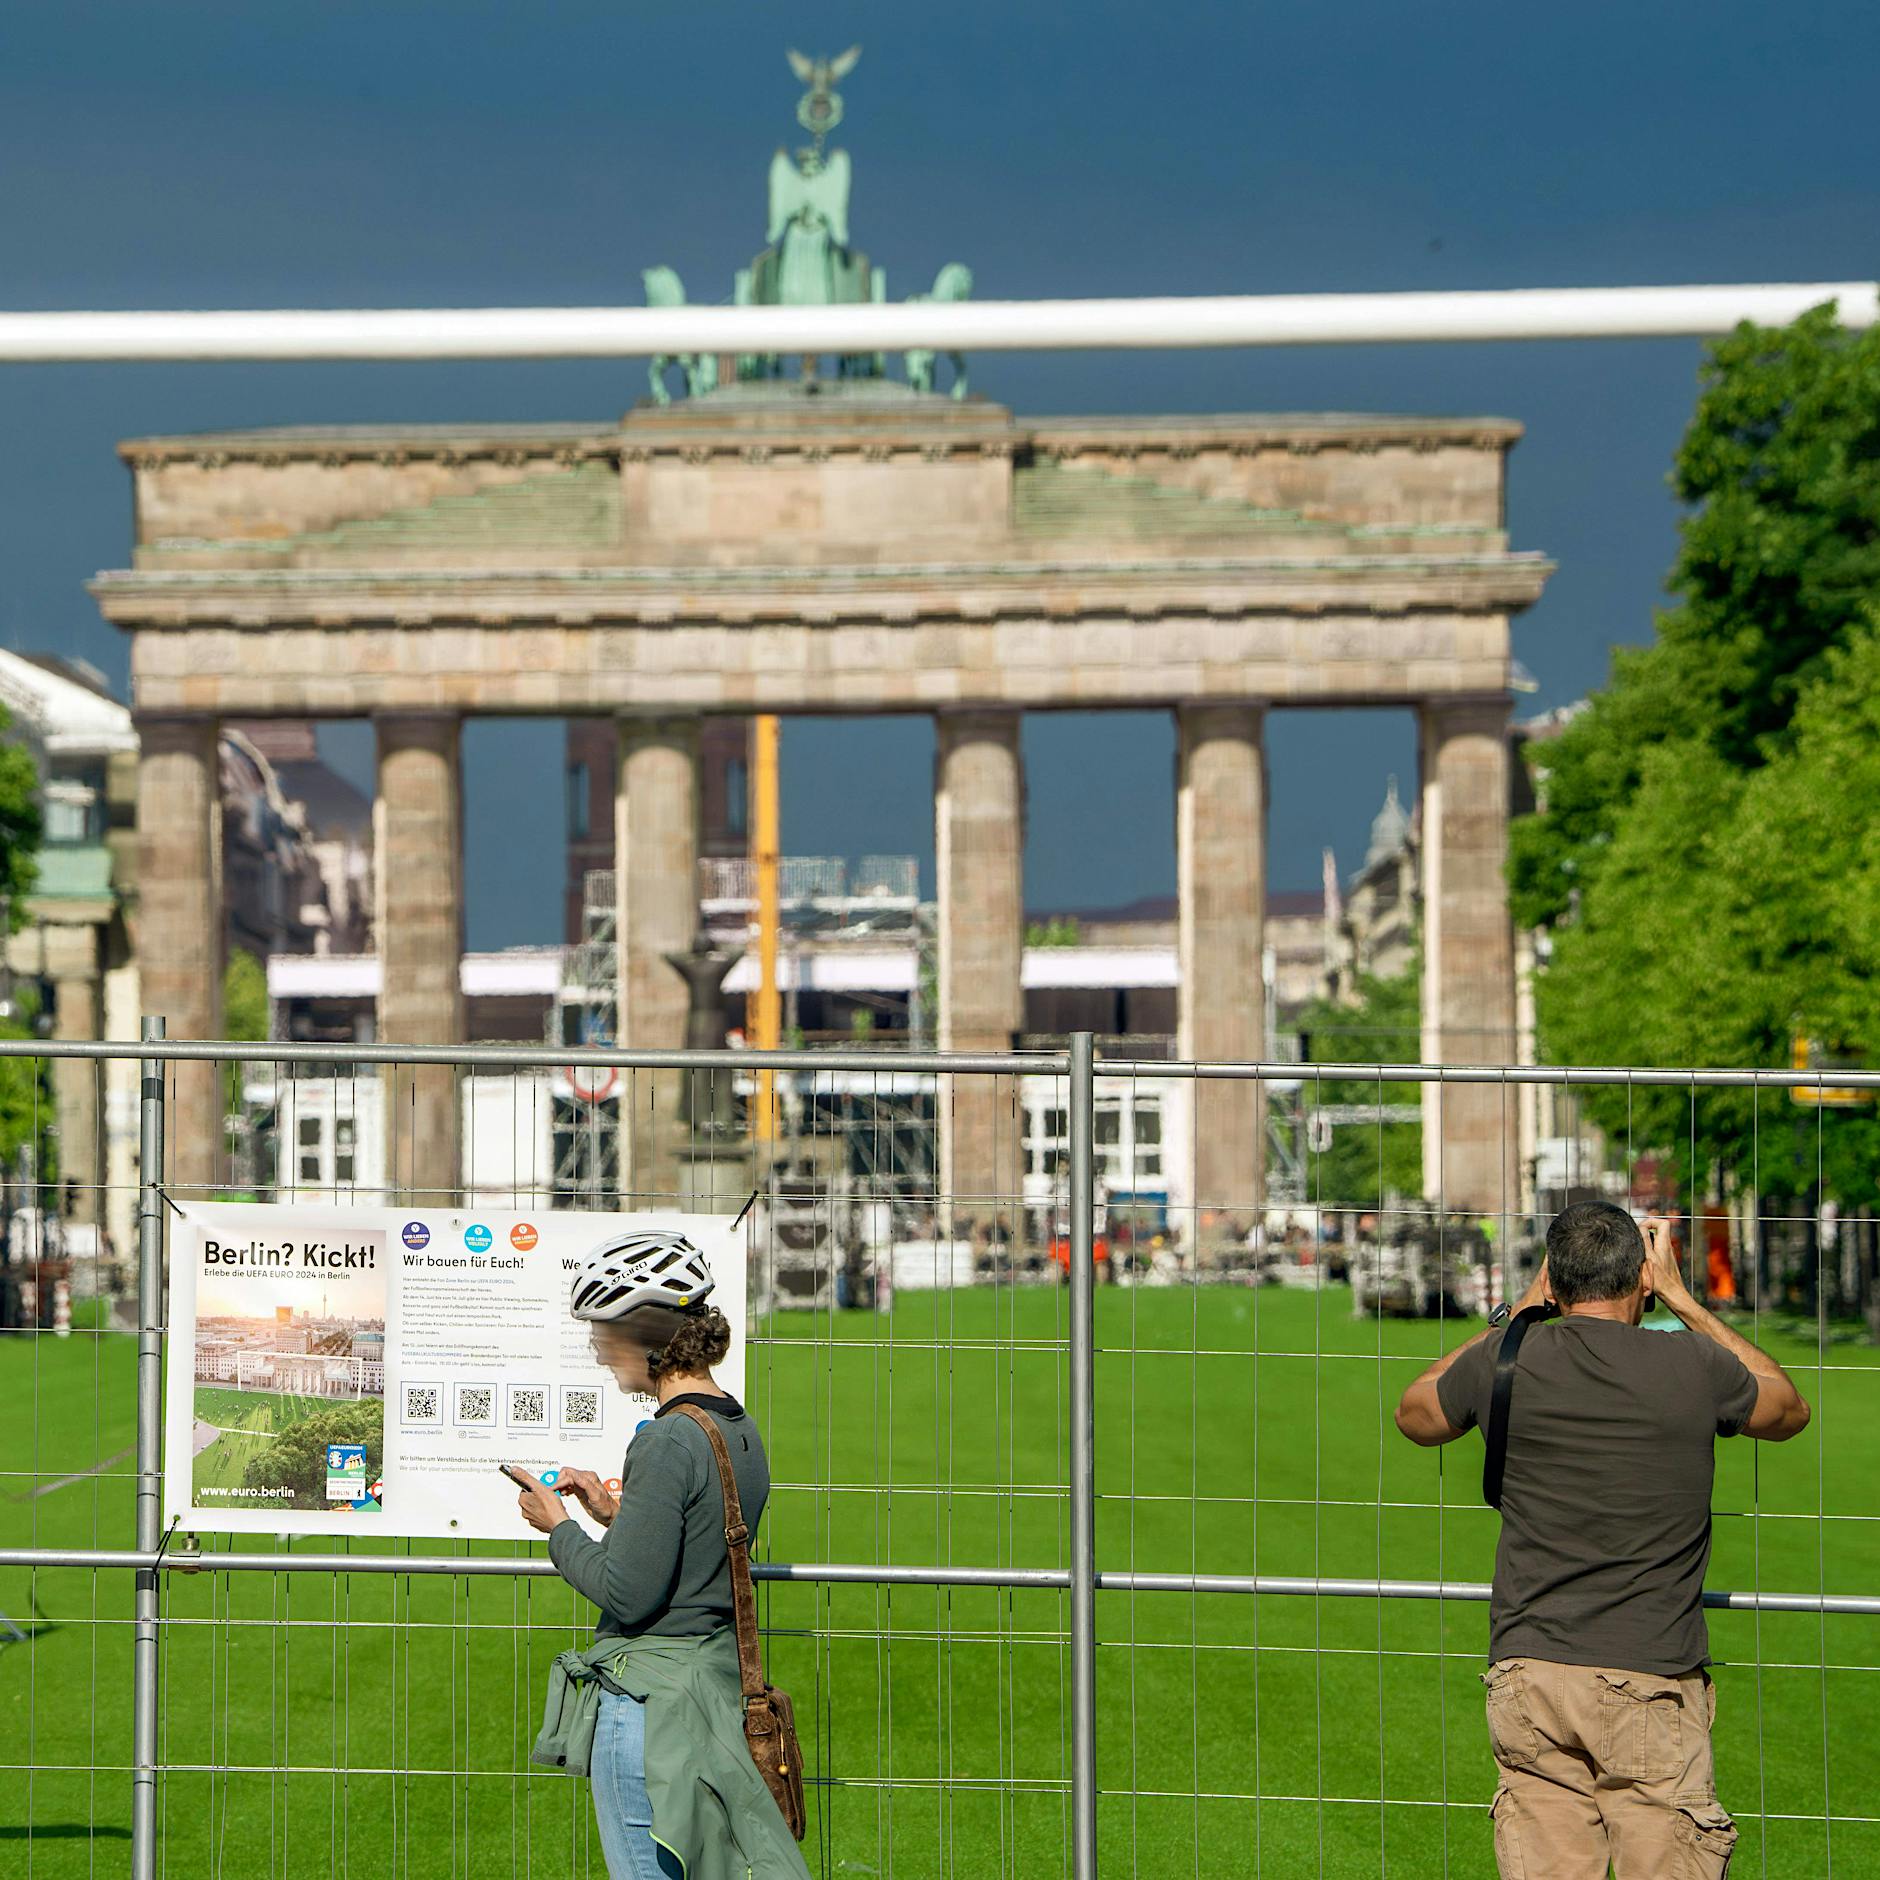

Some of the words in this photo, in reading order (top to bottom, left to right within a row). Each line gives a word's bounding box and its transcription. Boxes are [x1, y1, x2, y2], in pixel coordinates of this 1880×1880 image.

[205, 1241, 295, 1267] Berlin?
[304, 1243, 376, 1269] Kickt!
[403, 1255, 424, 1267] Wir
[427, 1255, 467, 1268] bauen
[470, 1256, 488, 1268] für
[490, 1257, 524, 1269] Euch!
[204, 1268, 232, 1277] Erlebe
[232, 1269, 245, 1277] die
[246, 1270, 268, 1278] UEFA
[269, 1270, 295, 1279] EURO
[295, 1271, 317, 1279] 2024
[318, 1271, 326, 1279] in
[327, 1271, 351, 1280] Berlin
[621, 1260, 649, 1280] GIRO
[436, 1455, 469, 1463] Verständnis
[200, 1486, 295, 1498] www.euro.berlin
